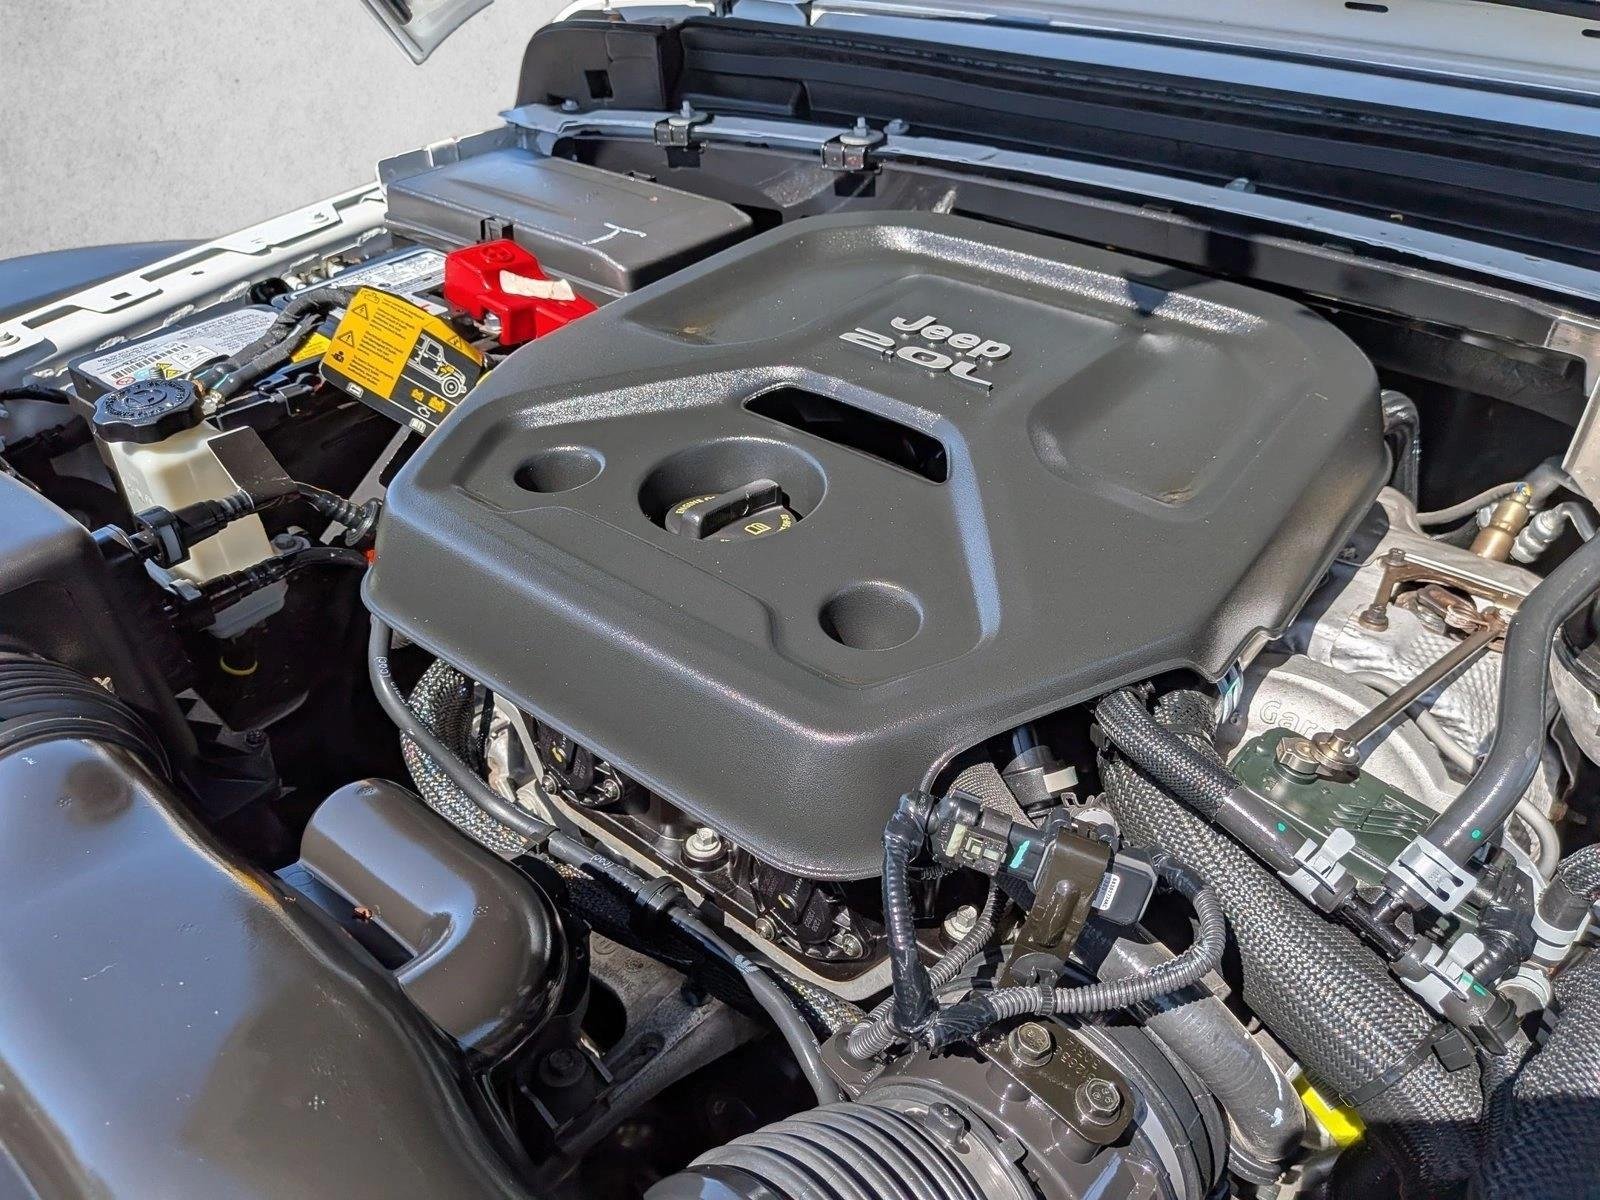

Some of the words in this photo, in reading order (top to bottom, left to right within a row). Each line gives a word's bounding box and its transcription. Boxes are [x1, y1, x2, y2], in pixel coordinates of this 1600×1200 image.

[838, 327, 993, 386] 2.0L
[890, 315, 1011, 358] Jeep
[1259, 700, 1325, 737] Gar
